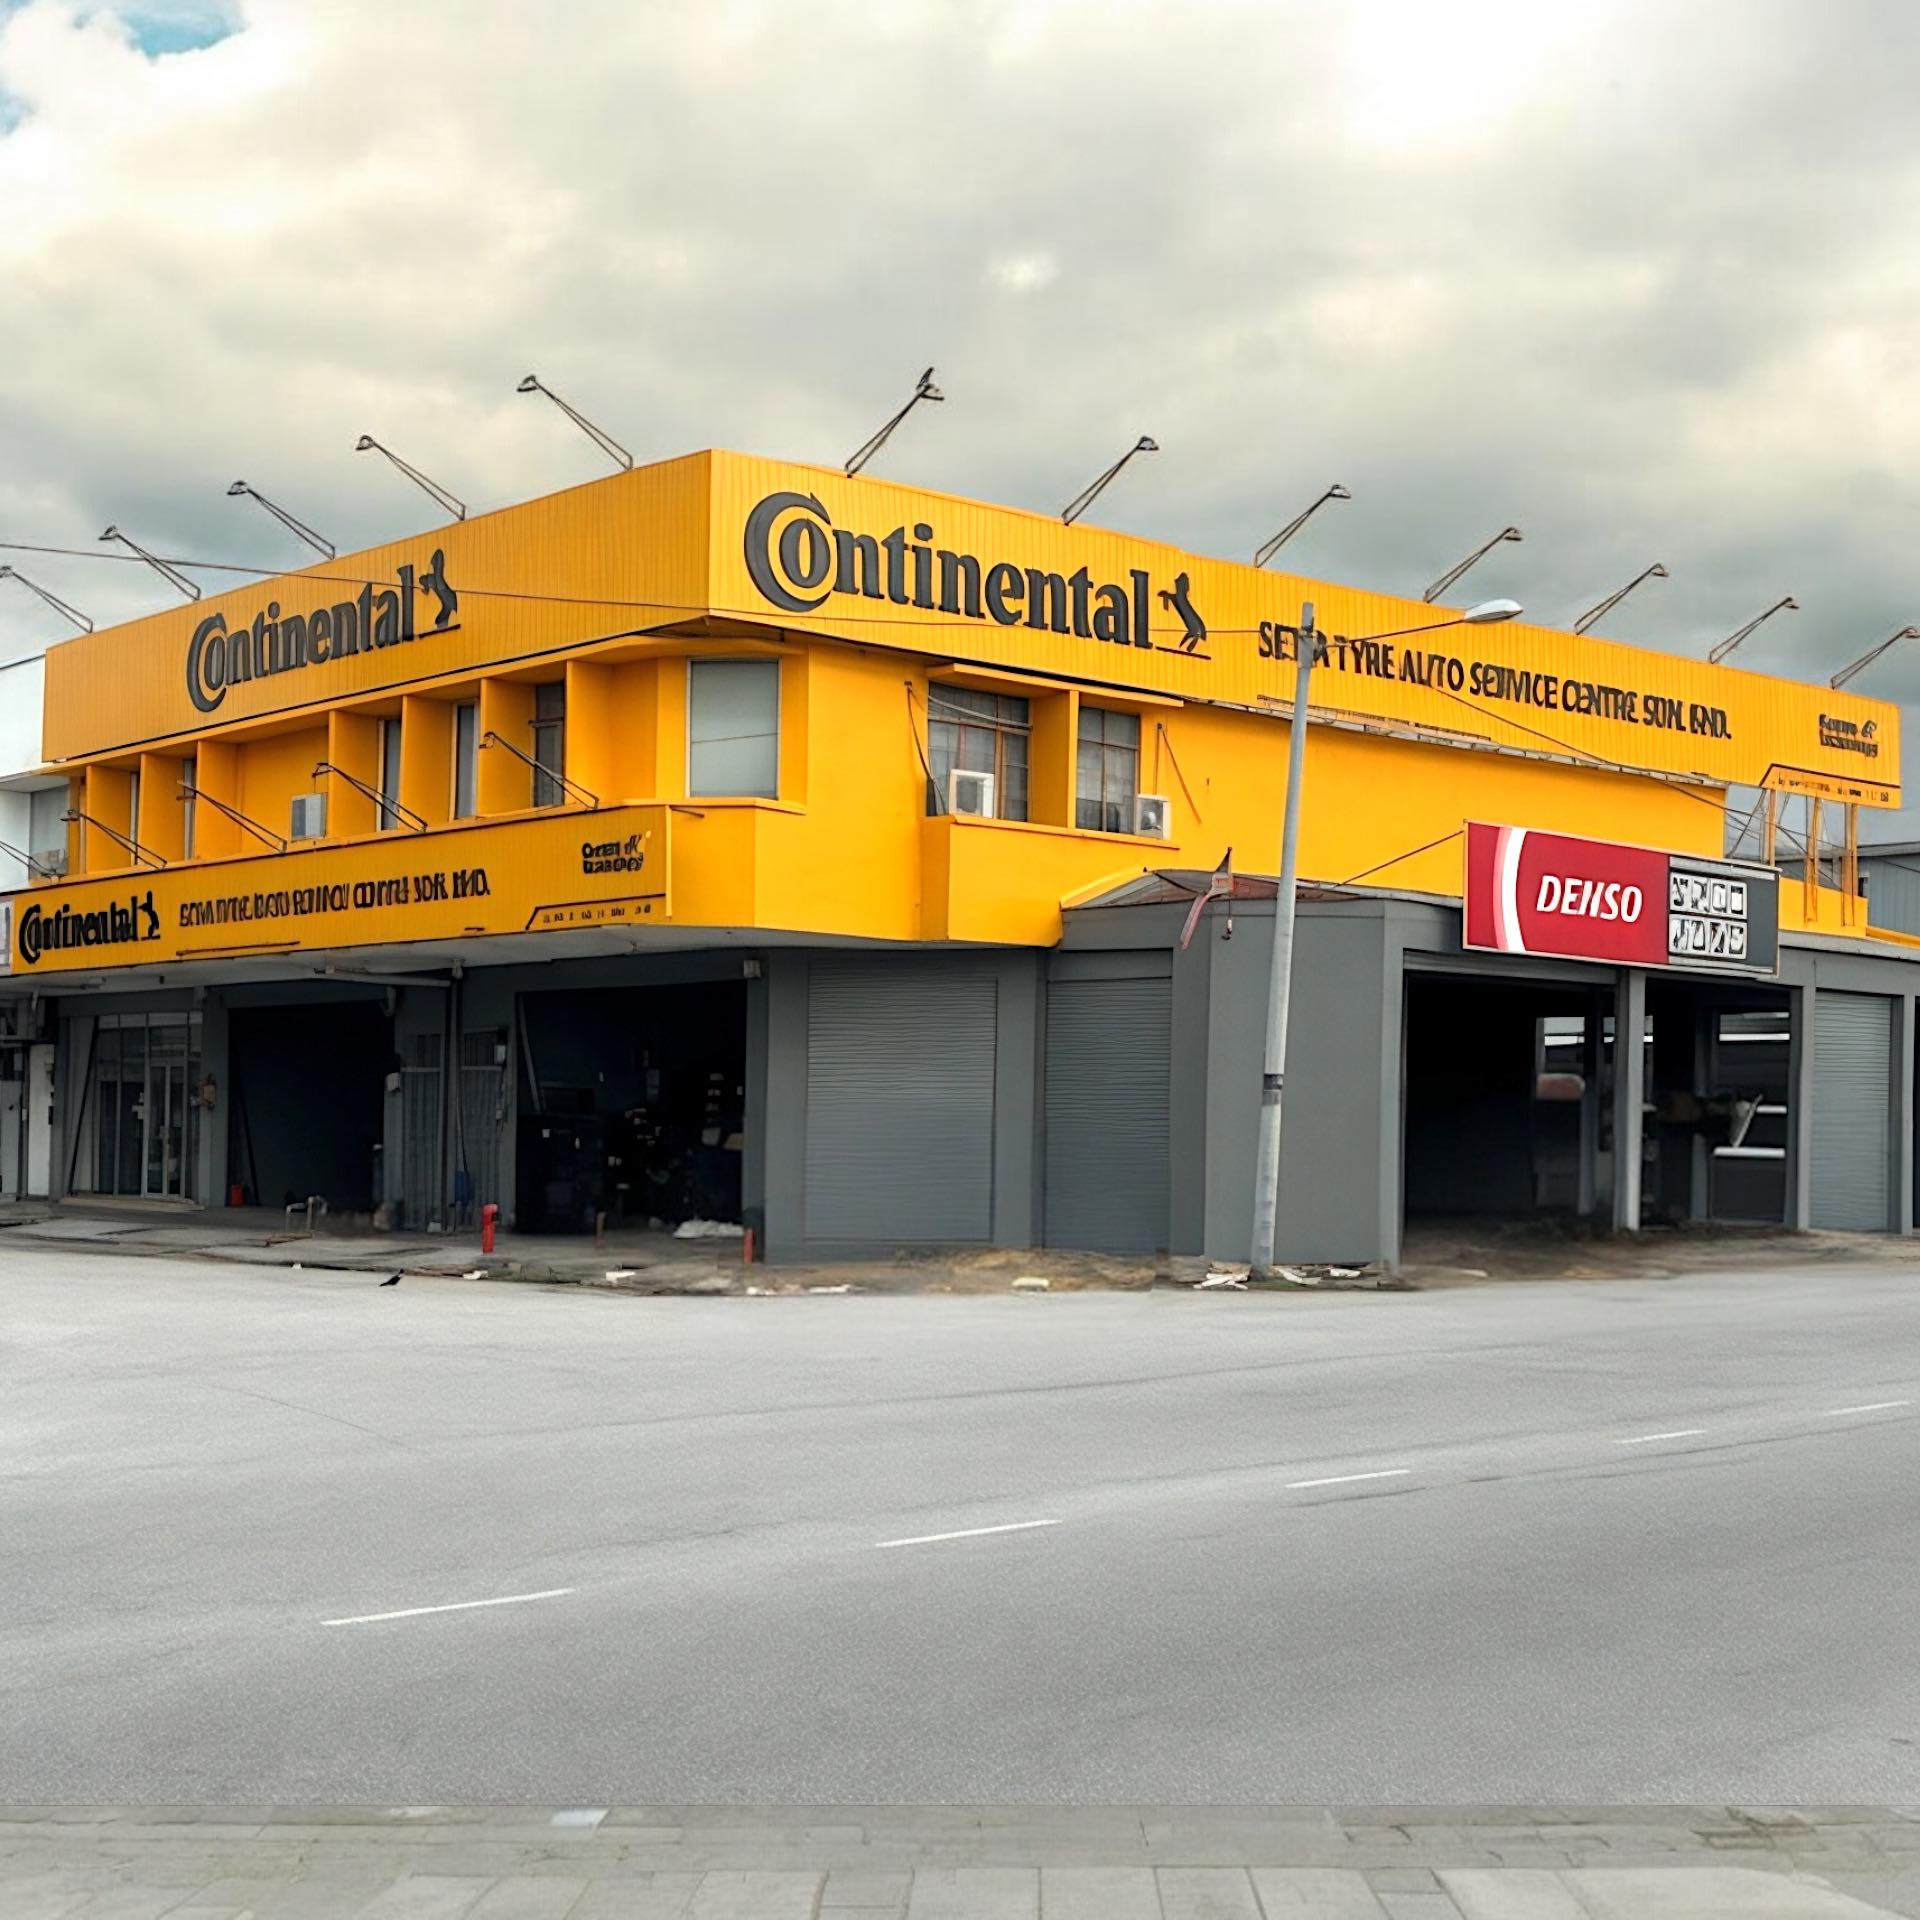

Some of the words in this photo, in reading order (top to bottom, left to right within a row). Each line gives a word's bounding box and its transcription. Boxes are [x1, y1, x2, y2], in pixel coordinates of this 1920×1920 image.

[743, 491, 1154, 650] Continental
[186, 564, 414, 712] Continental
[1333, 634, 1396, 680] TYRE
[1398, 648, 1465, 693] AUTO
[1536, 875, 1643, 923] DENSO
